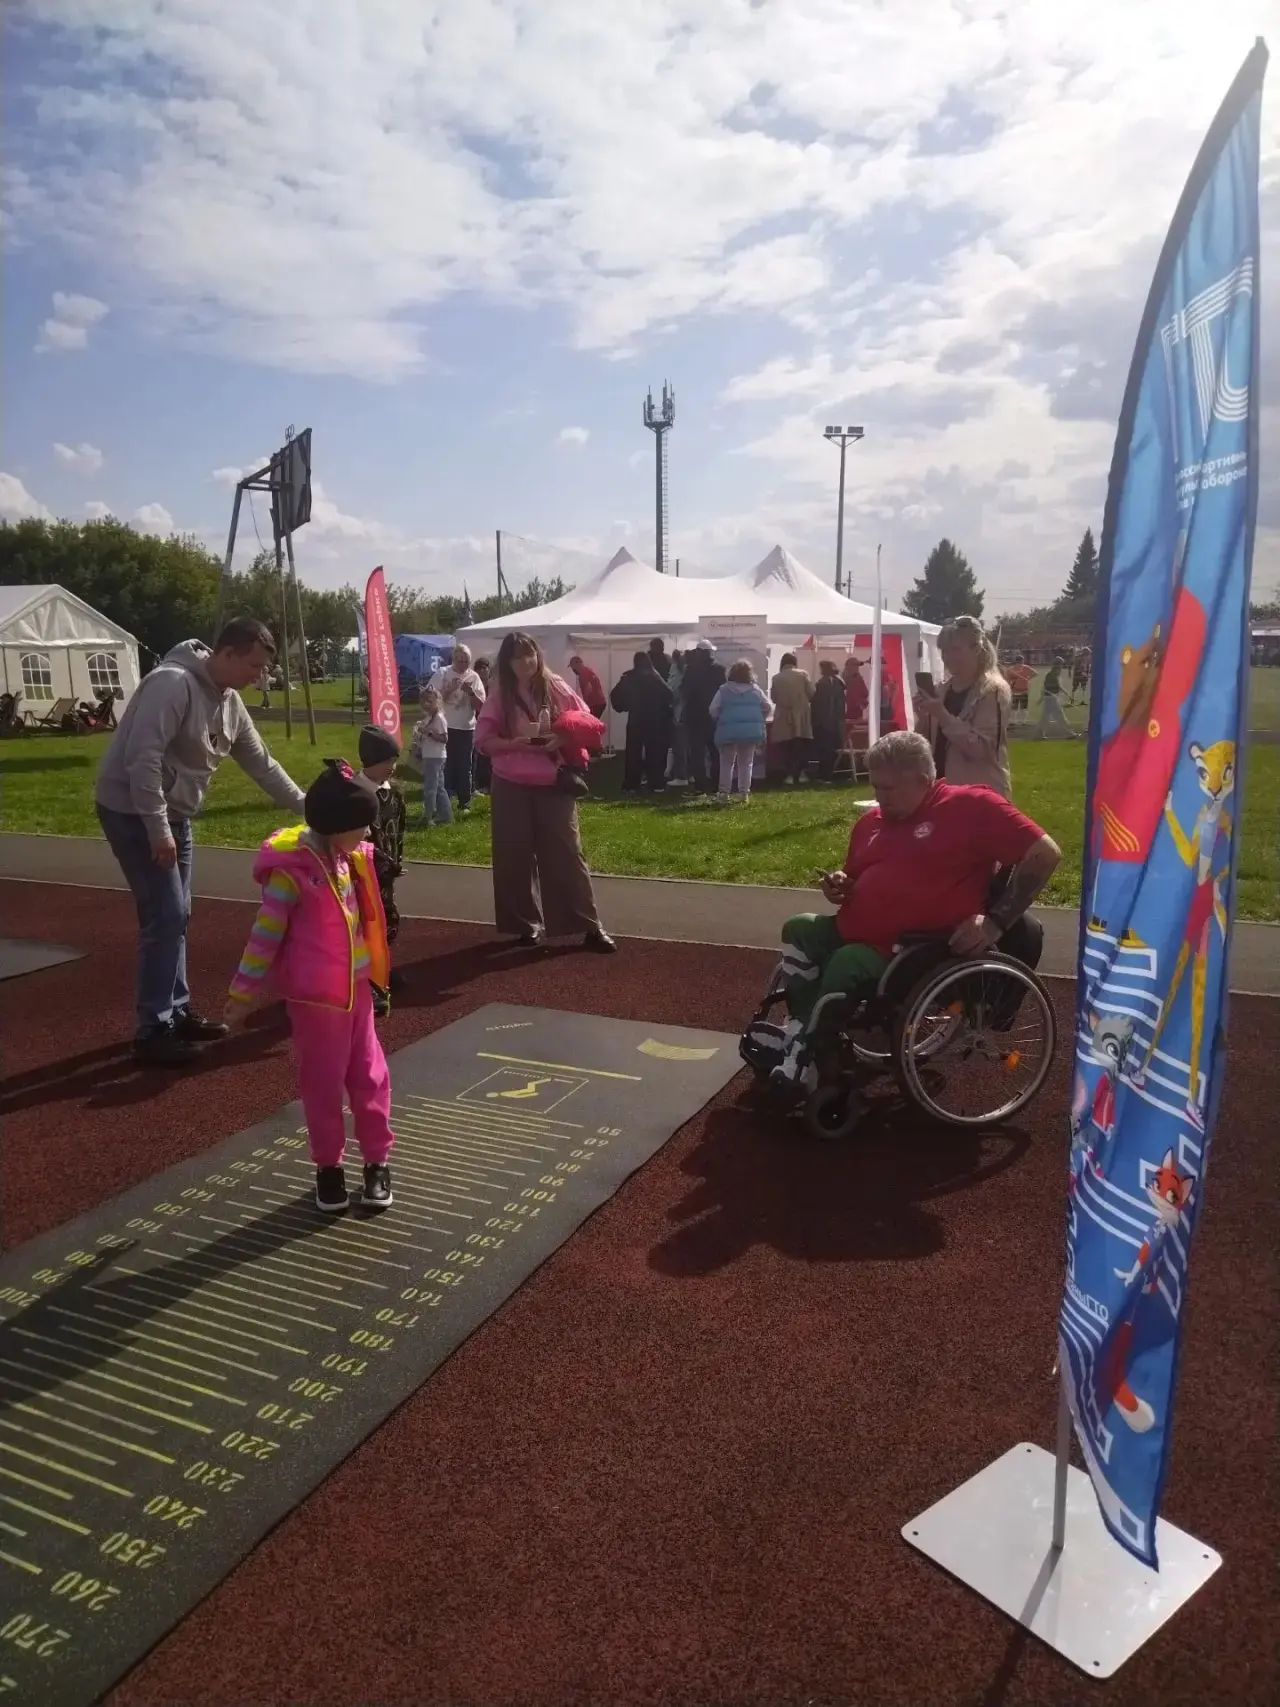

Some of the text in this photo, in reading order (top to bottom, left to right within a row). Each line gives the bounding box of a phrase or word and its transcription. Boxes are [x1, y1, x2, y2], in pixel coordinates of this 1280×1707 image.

[597, 1126, 622, 1136] 50
[273, 1136, 307, 1149] 100
[584, 1137, 609, 1147] 60
[252, 1148, 288, 1161] 110
[570, 1149, 595, 1160] 70
[229, 1161, 264, 1174] 120
[555, 1161, 581, 1173] 80
[205, 1174, 241, 1188] 130
[539, 1175, 567, 1187] 90
[180, 1188, 217, 1202] 140
[520, 1188, 557, 1203] 100
[153, 1202, 191, 1217] 150
[503, 1202, 541, 1217] 110
[125, 1218, 164, 1233] 160
[484, 1217, 523, 1233] 120
[465, 1233, 505, 1249] 130
[445, 1250, 485, 1267] 140
[423, 1268, 465, 1286] 150
[0, 1287, 41, 1306] 200
[400, 1287, 444, 1306] 160
[375, 1307, 421, 1328] 170
[349, 1330, 394, 1352] 180
[321, 1353, 369, 1376] 190
[287, 1377, 344, 1402] 200
[256, 1403, 315, 1430] 210
[221, 1430, 281, 1460] 220
[183, 1461, 245, 1493] 230
[143, 1495, 208, 1529] 240
[99, 1531, 167, 1569] 250
[50, 1571, 121, 1611] 260
[0, 1613, 71, 1657] 270
